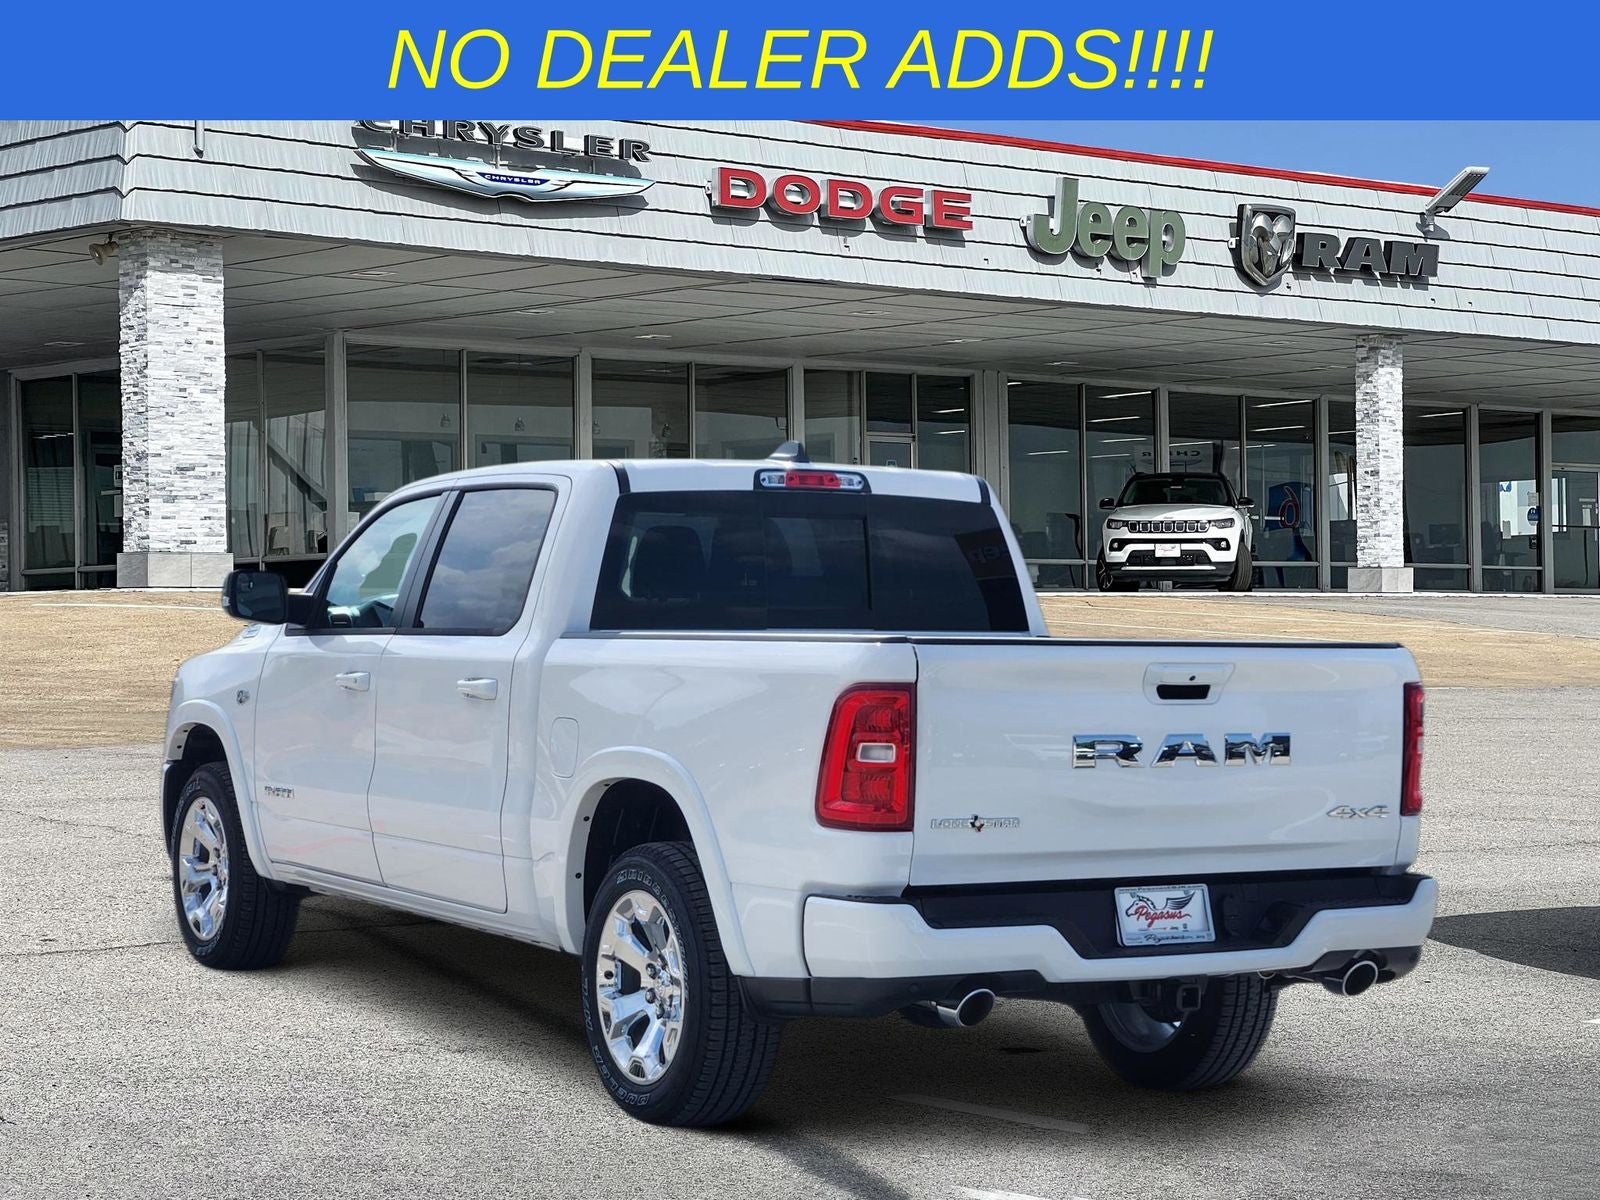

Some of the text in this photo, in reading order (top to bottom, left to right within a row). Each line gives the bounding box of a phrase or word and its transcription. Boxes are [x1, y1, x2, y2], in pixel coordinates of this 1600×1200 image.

[484, 173, 541, 185] CHRYSLER
[712, 166, 973, 230] DODGE
[1029, 177, 1186, 278] Jeep
[1299, 232, 1439, 277] RAM
[1072, 732, 1291, 768] RAM
[931, 817, 1020, 829] LONE STAR
[1327, 805, 1389, 819] 4x4
[1135, 905, 1191, 928] Pegasus
